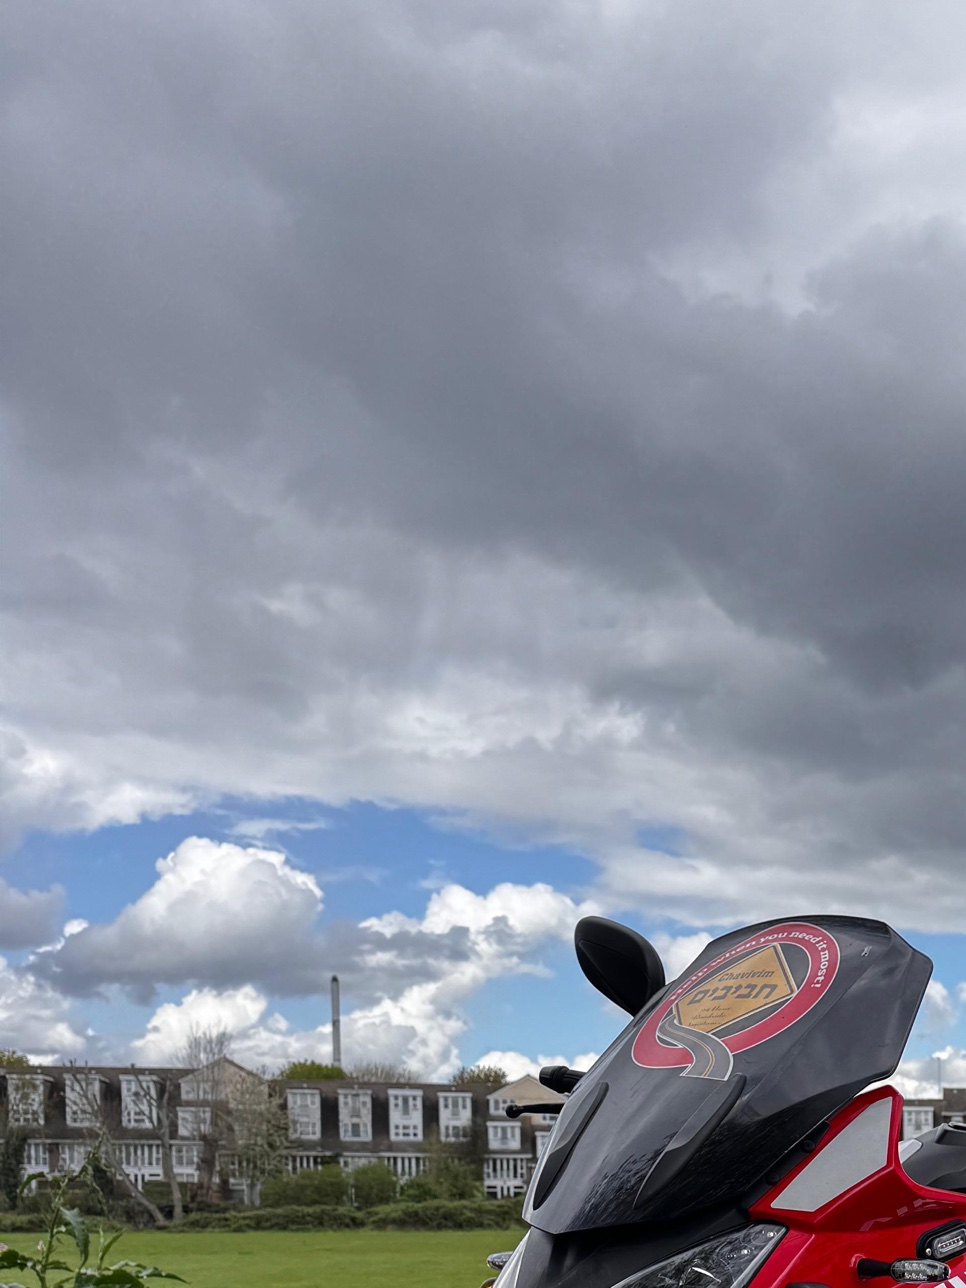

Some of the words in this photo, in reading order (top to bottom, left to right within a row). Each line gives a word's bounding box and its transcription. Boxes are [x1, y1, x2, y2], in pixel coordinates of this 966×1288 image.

[759, 931, 788, 944] you
[788, 931, 822, 944] need
[815, 940, 828, 951] it
[718, 969, 775, 982] Chavivim
[687, 983, 778, 1006] חביבים
